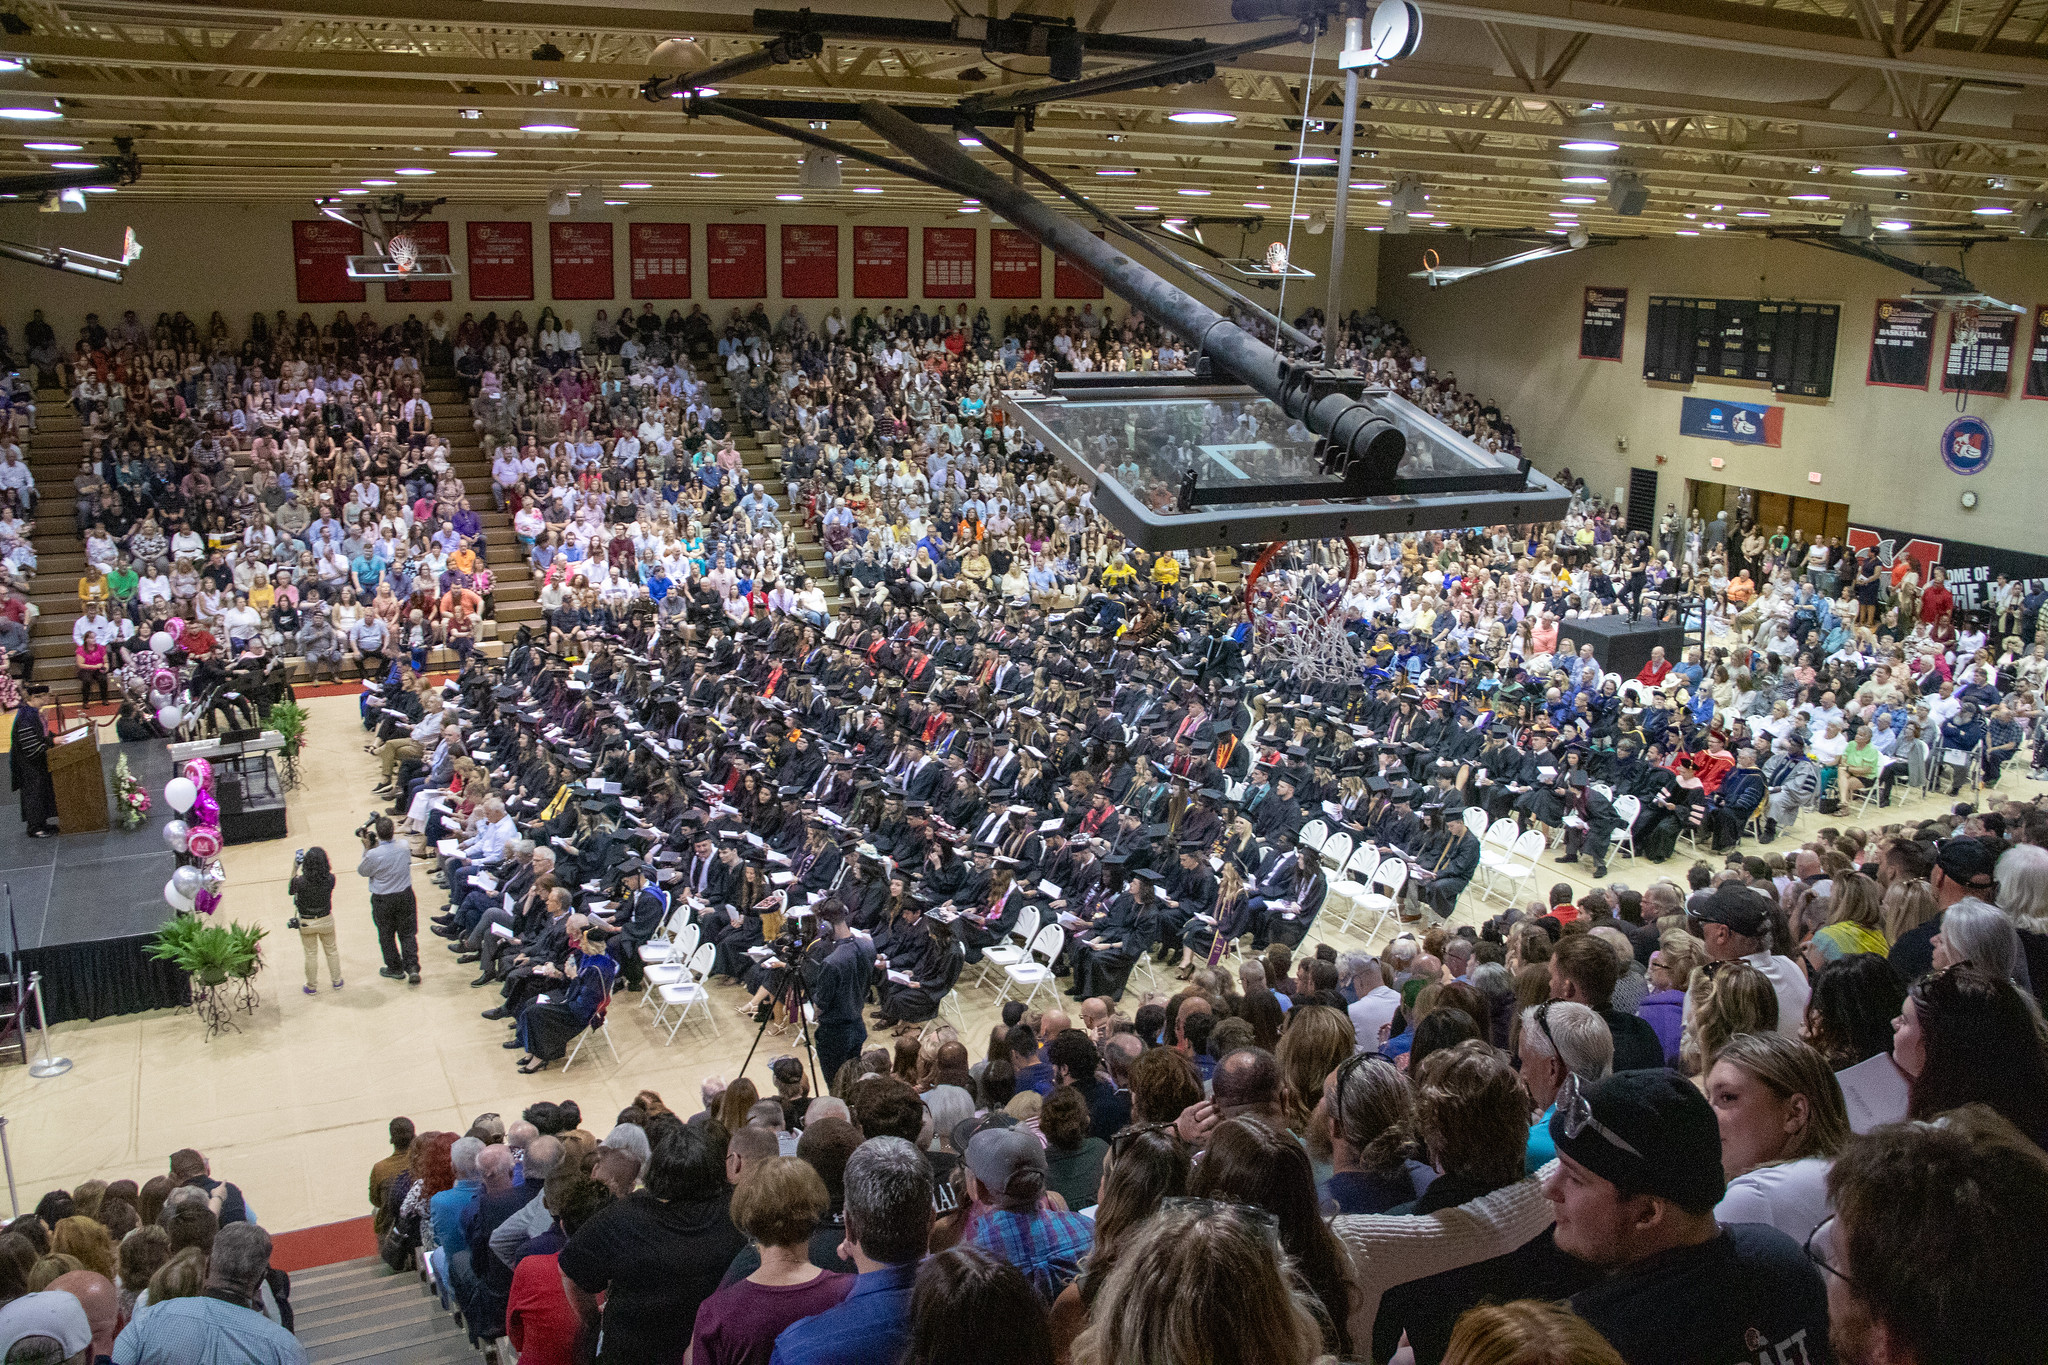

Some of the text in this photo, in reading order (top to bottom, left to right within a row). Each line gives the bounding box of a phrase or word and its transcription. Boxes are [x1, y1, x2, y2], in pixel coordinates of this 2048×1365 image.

[1586, 311, 1621, 319] BASKETBALL
[1725, 328, 1744, 336] period
[1879, 328, 1928, 338] BASKETBALL
[1946, 565, 1990, 584] OME OF
[1951, 583, 1981, 611] HE
